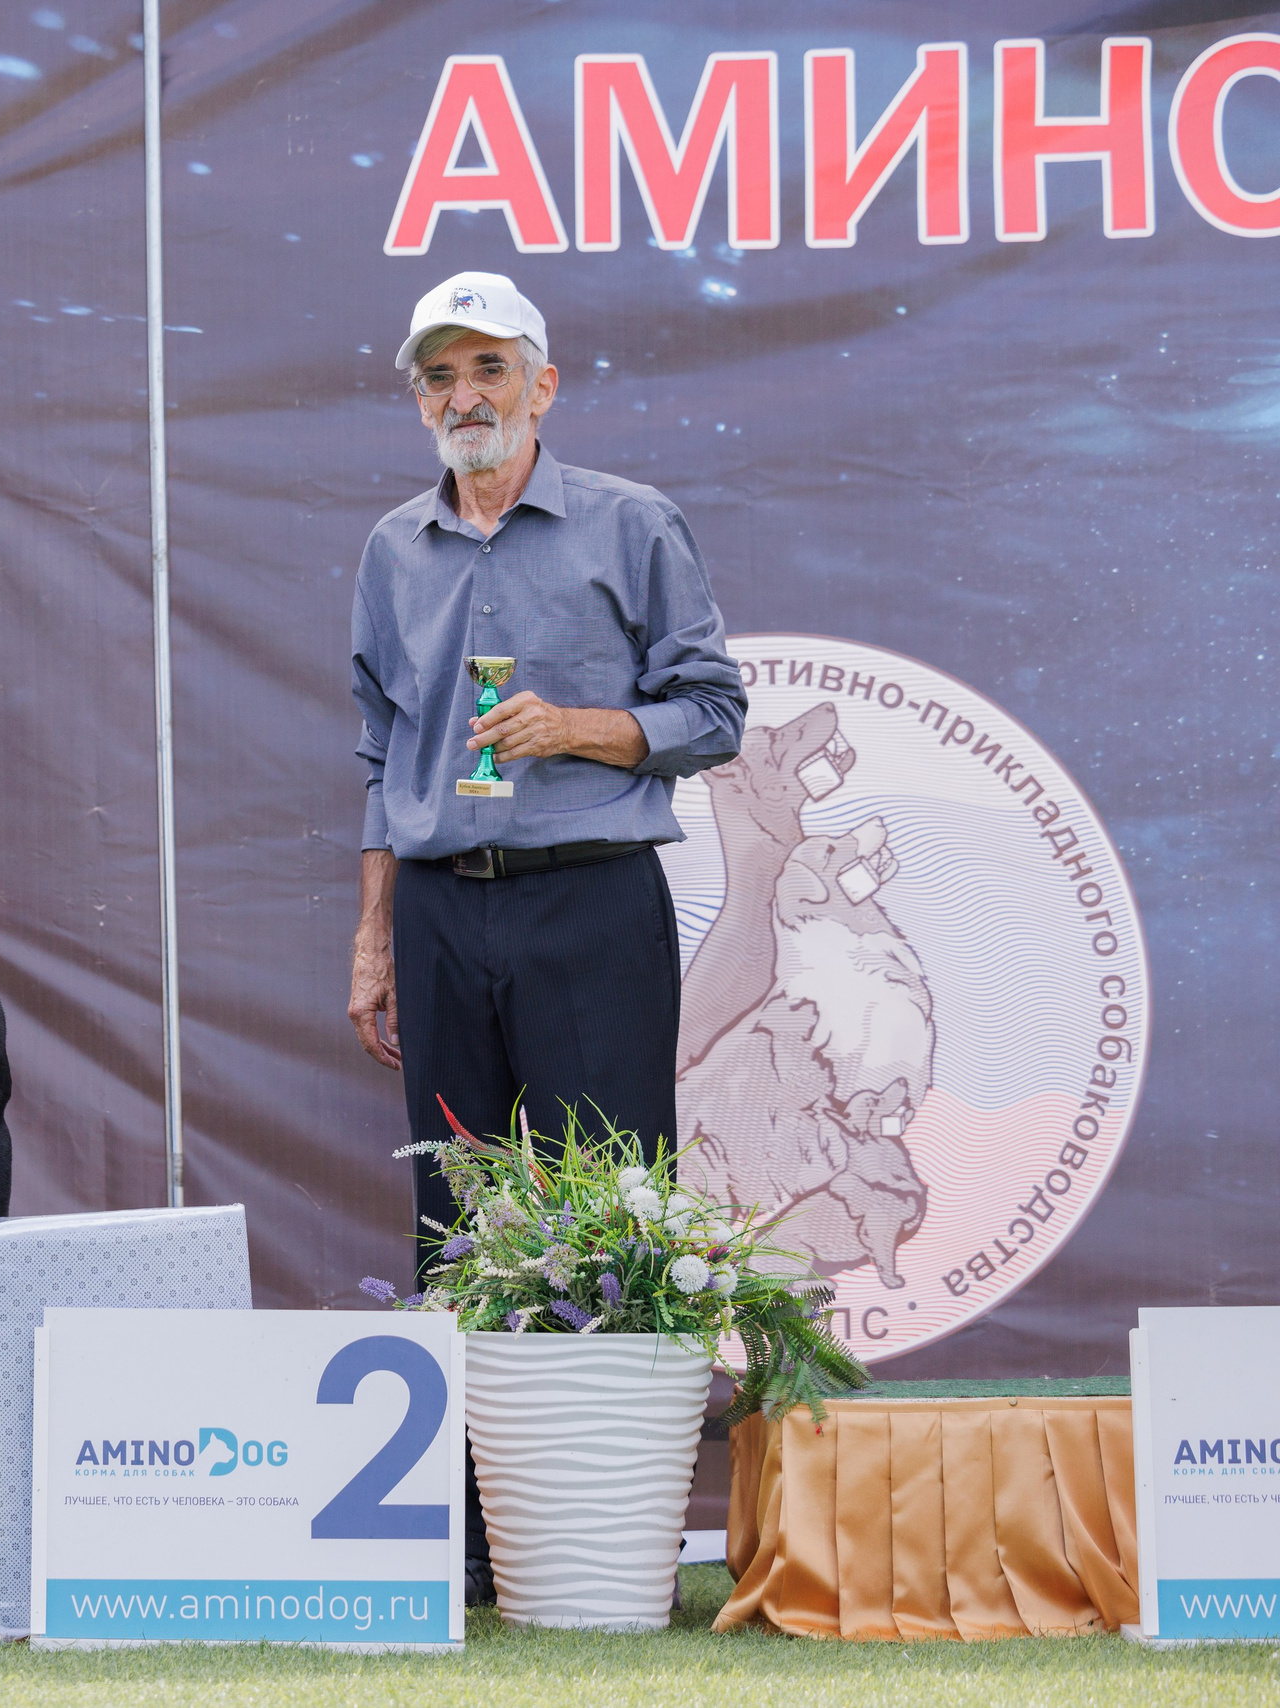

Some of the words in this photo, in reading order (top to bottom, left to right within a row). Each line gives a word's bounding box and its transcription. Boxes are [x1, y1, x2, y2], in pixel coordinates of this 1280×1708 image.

[931, 974, 1132, 1298] собаководства
[311, 1334, 450, 1540] 2
[75, 1469, 116, 1477] КОРМА
[123, 1469, 147, 1477] ДЛЯ
[154, 1469, 196, 1477] СОБАК
[1221, 1467, 1245, 1475] ДЛЯ
[1252, 1467, 1280, 1475] СОБ
[64, 1495, 111, 1507] ЛУЧШЕЕ,
[113, 1496, 133, 1506] ЧТО
[135, 1496, 161, 1506] ЕСТЬ
[162, 1496, 170, 1506] У
[172, 1496, 225, 1506] ЧЕЛОВЕКА
[236, 1496, 256, 1507] ЭТО
[258, 1496, 299, 1507] СОБАКА
[1164, 1494, 1210, 1505] ЛУЧШЕЕ,
[1212, 1494, 1232, 1504] ЧТО
[1234, 1494, 1260, 1504] ЕСТЬ
[1261, 1494, 1268, 1504] У
[70, 1584, 429, 1631] www.aminodog.ru
